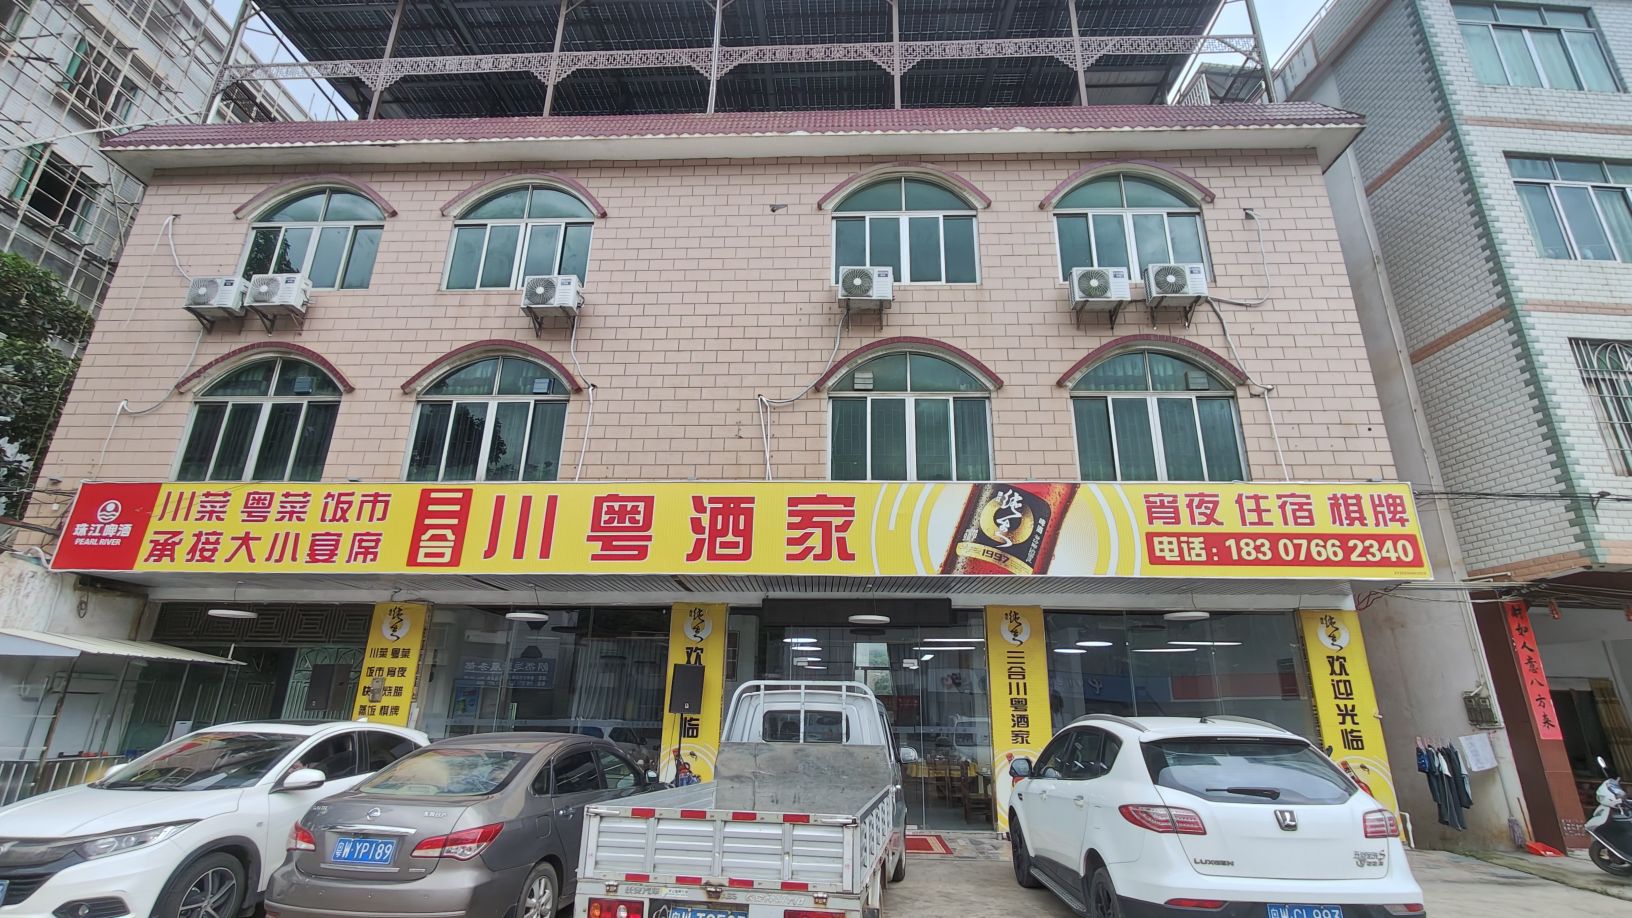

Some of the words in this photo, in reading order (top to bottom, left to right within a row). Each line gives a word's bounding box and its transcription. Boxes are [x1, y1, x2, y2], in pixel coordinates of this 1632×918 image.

[158, 491, 232, 522] 川菜
[240, 491, 312, 523] 粤菜
[319, 491, 392, 523] 饭市
[1143, 492, 1225, 527] 宵夜
[1235, 492, 1316, 528] 住宿
[1327, 492, 1411, 528] 棋牌
[72, 523, 133, 537] 珠江啤酒
[74, 538, 98, 546] PEARL
[99, 538, 122, 546] RIVER
[415, 491, 465, 564] 三合
[482, 493, 857, 563] 川粤酒家
[143, 530, 384, 564] 承接大小宴席
[981, 547, 1012, 564] 1997
[1225, 537, 1273, 561] 183
[1278, 538, 1344, 562] 0766
[1350, 538, 1414, 563] 2340
[369, 647, 389, 658] 川菜
[391, 647, 412, 659] 粤菜
[682, 646, 705, 739] 欢临
[1006, 650, 1031, 745] 三合川粤酒家
[1326, 655, 1365, 751] 欢迎光临
